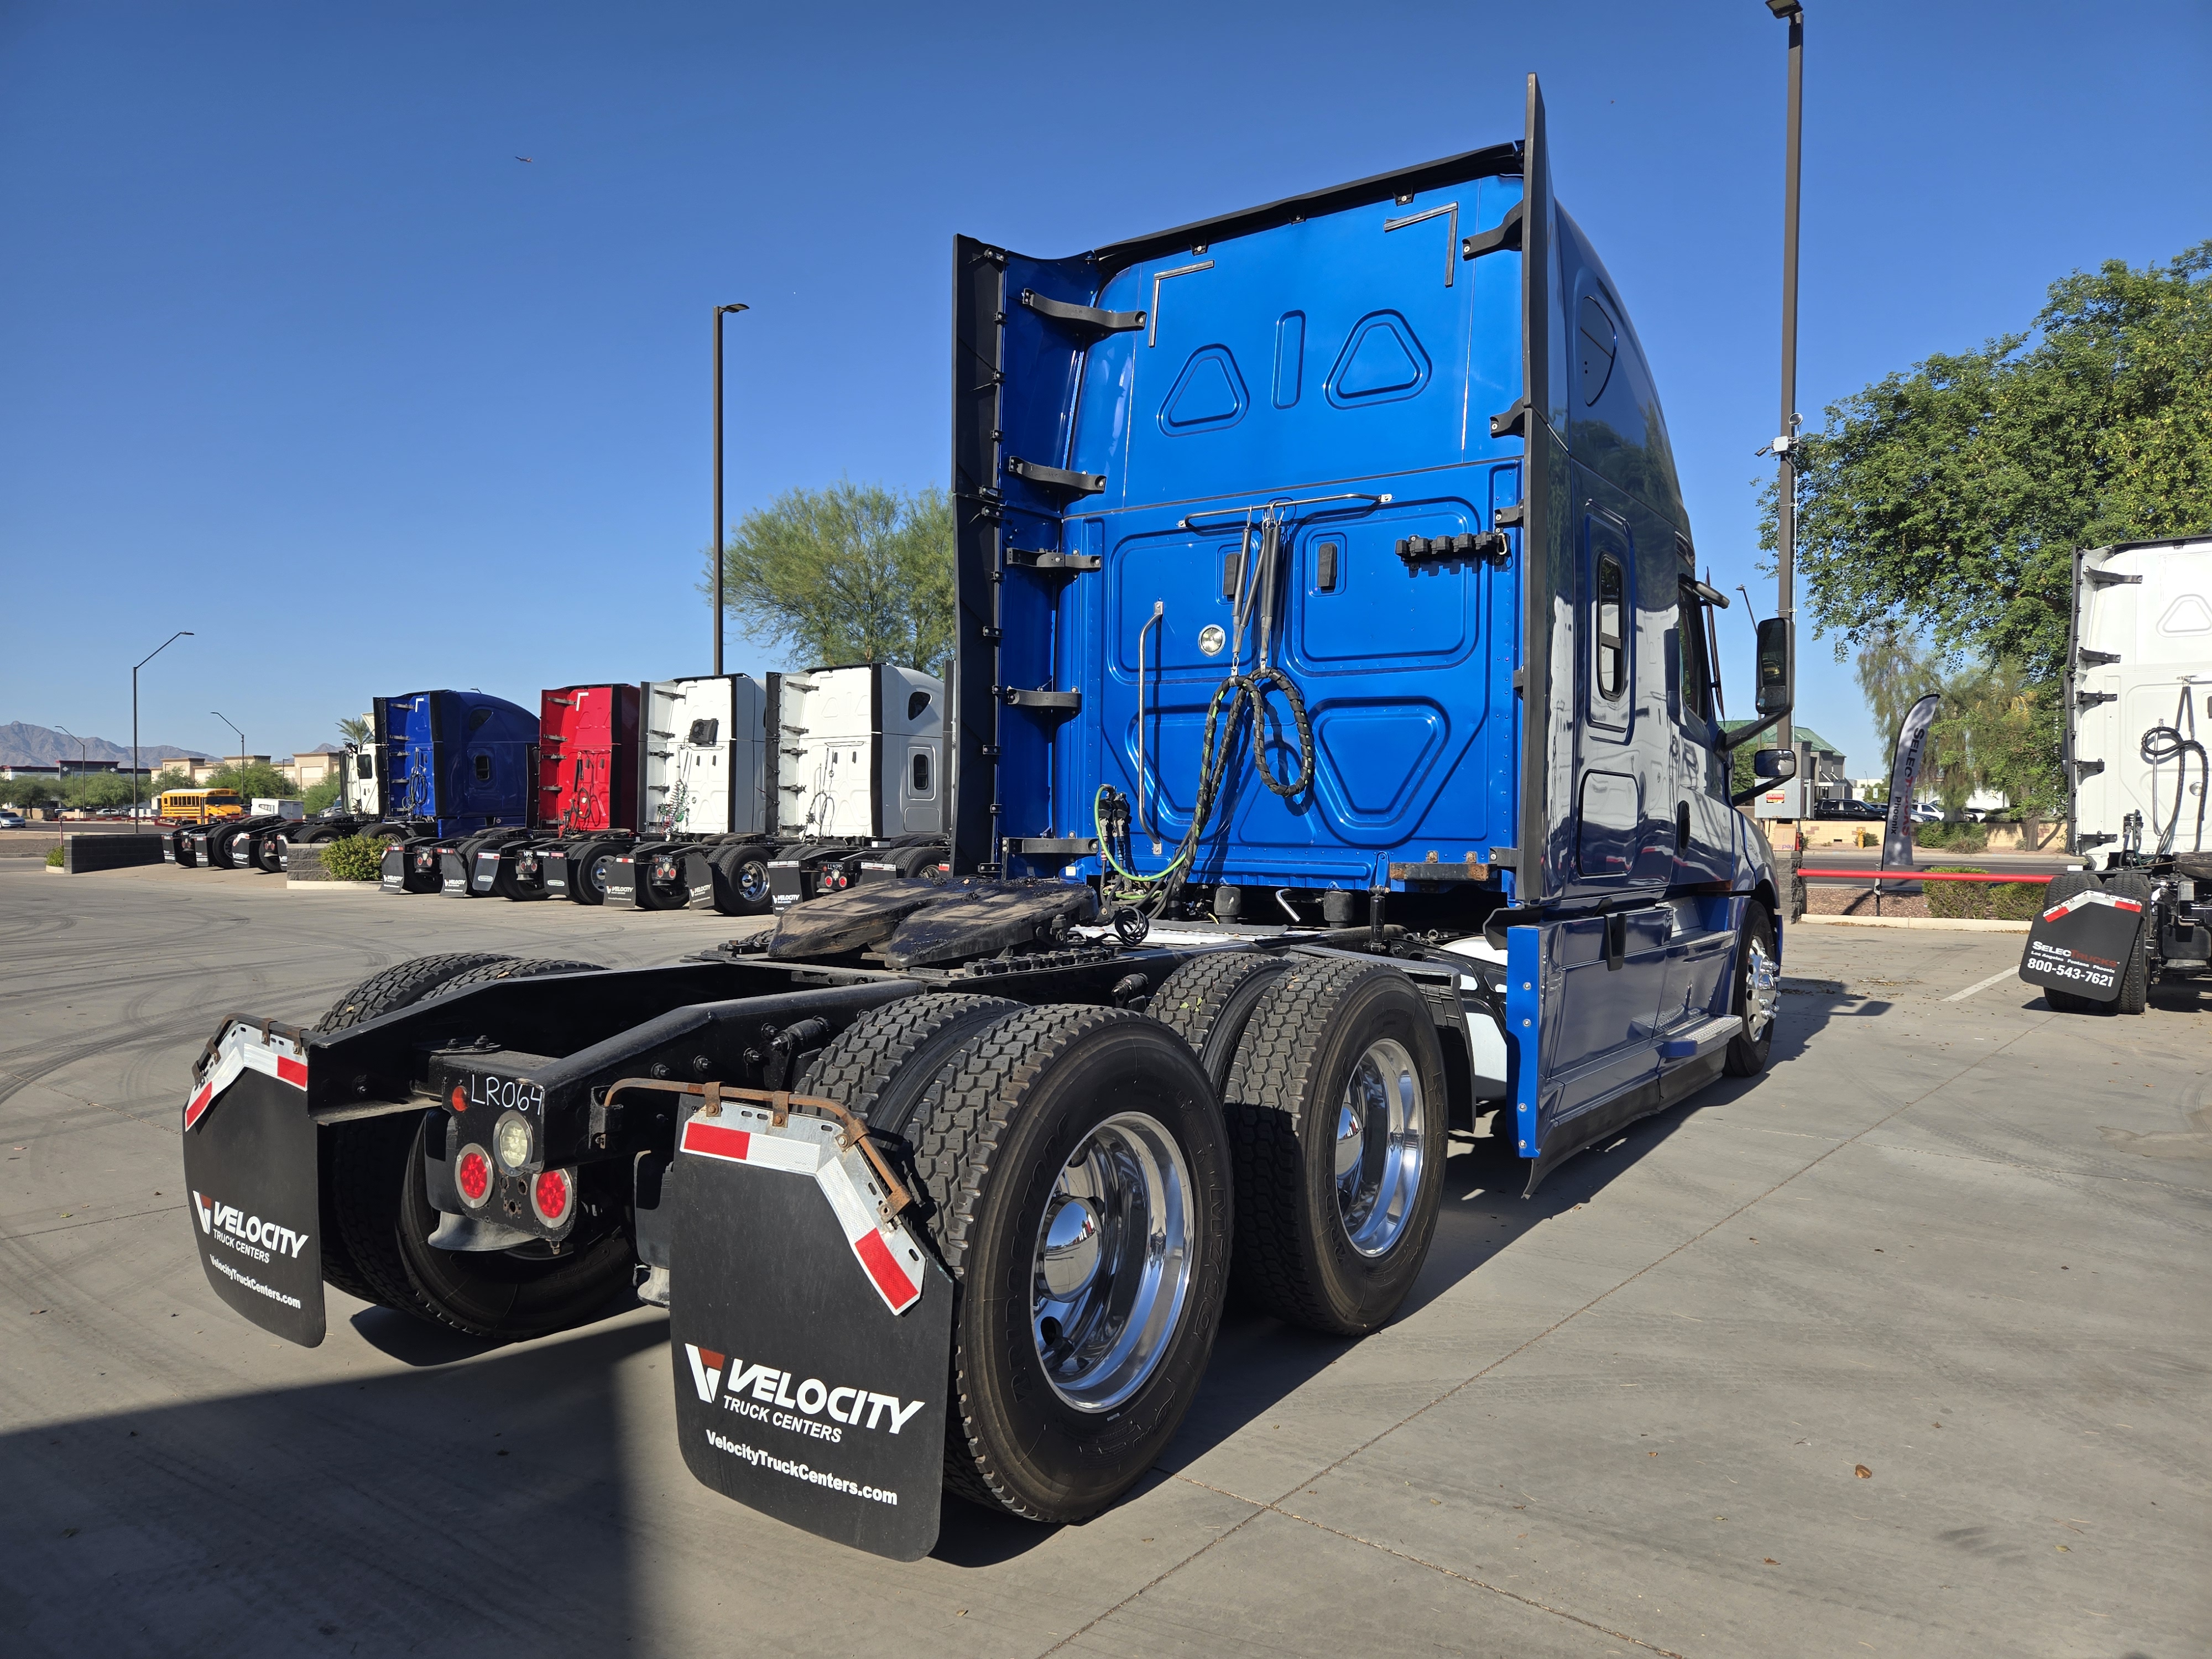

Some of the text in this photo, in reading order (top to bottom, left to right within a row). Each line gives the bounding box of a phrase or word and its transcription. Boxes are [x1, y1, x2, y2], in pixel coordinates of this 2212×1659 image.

[1891, 796, 1902, 834] Phoenix
[2027, 958, 2114, 987] 800-543-7621
[2093, 964, 2115, 973] Phoenix
[471, 1074, 543, 1115] LR064
[213, 1201, 309, 1258] VELOCITY
[213, 1228, 270, 1264] TRUCK CENTERS
[210, 1254, 301, 1309] VelocityTruckCenters.com
[1005, 1112, 1069, 1403] BRIDGESTONE
[723, 1395, 842, 1443] TRUCK CENTERS
[727, 1358, 925, 1434] VELOCITY
[706, 1430, 898, 1505] VelocityTruckCenters.com
